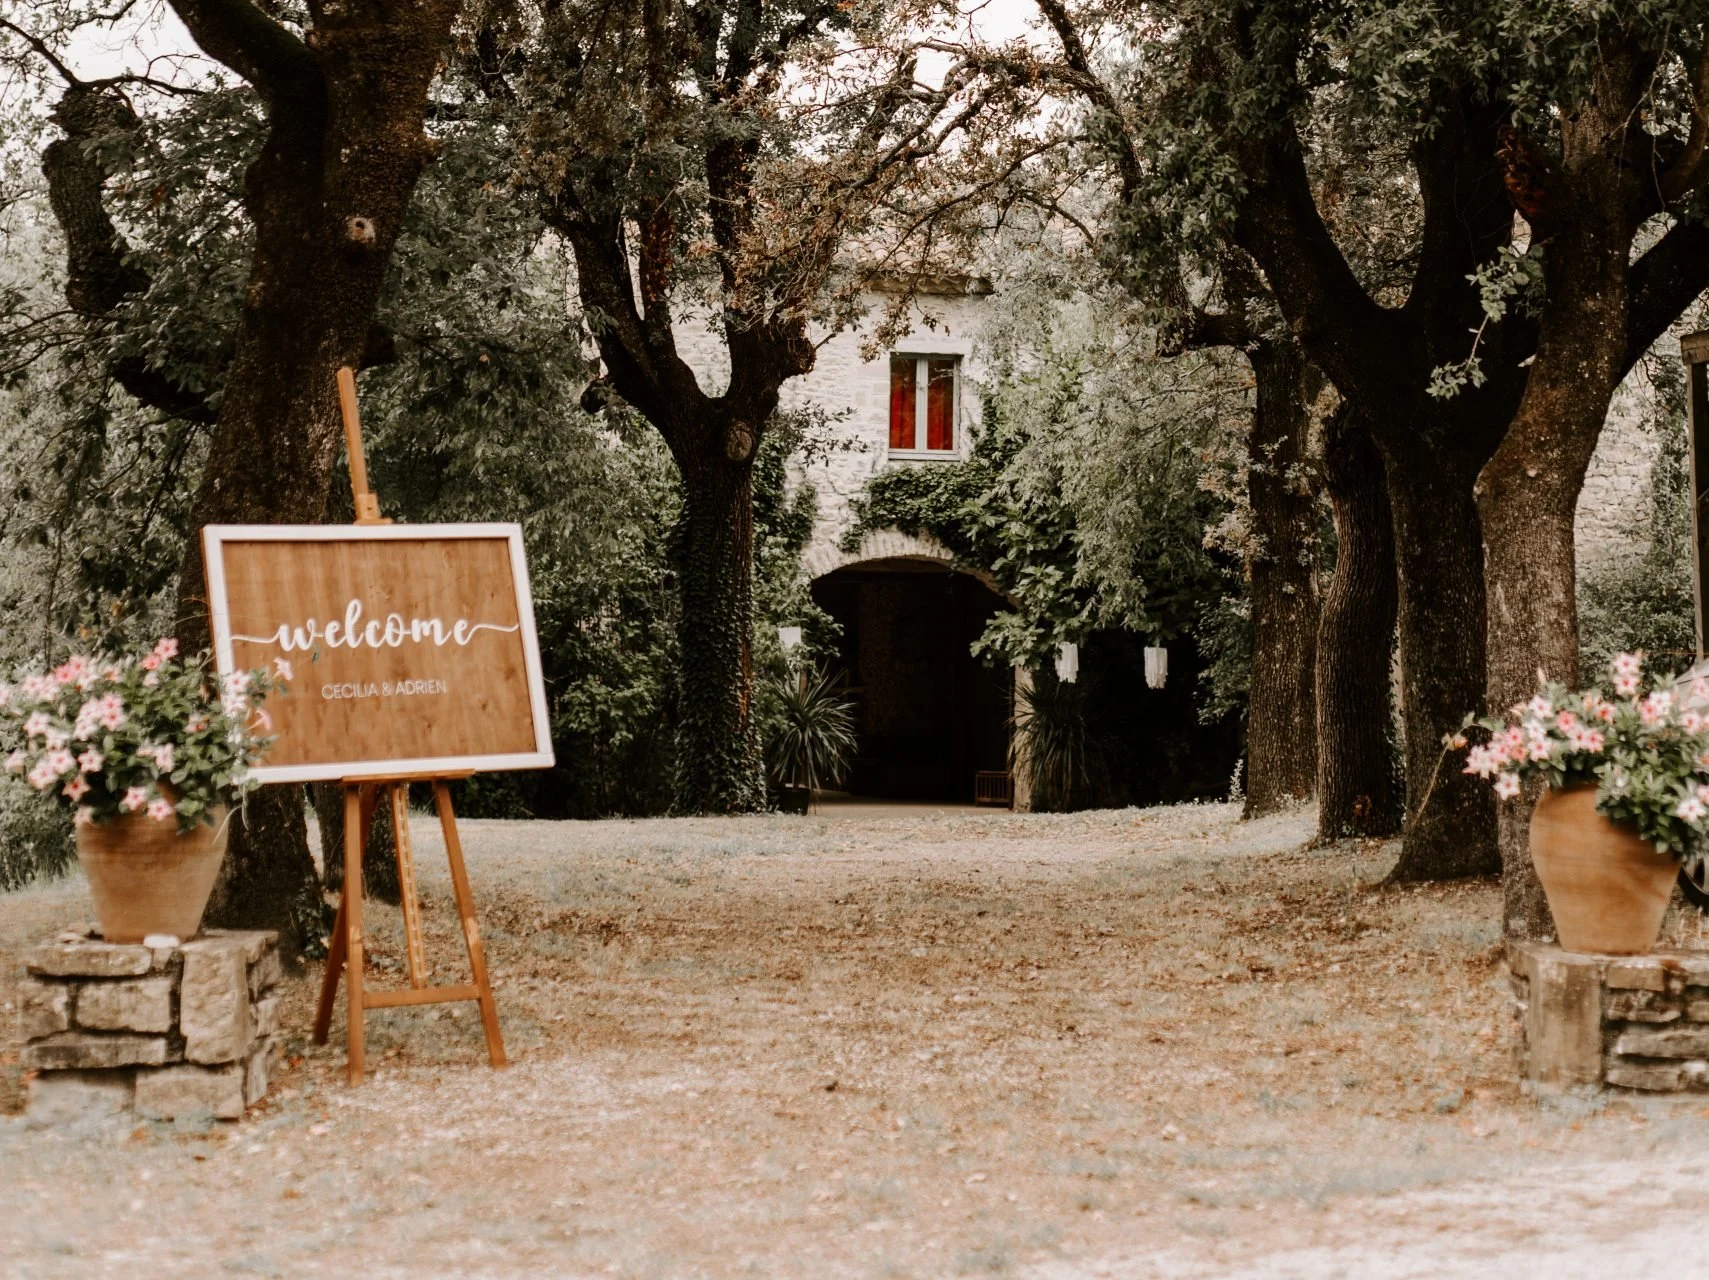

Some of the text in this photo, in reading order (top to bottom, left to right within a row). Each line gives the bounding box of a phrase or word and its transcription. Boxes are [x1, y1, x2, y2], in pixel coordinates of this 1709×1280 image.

[230, 598, 519, 651] welcome
[321, 680, 447, 699] CECILIA & ADRIEN
